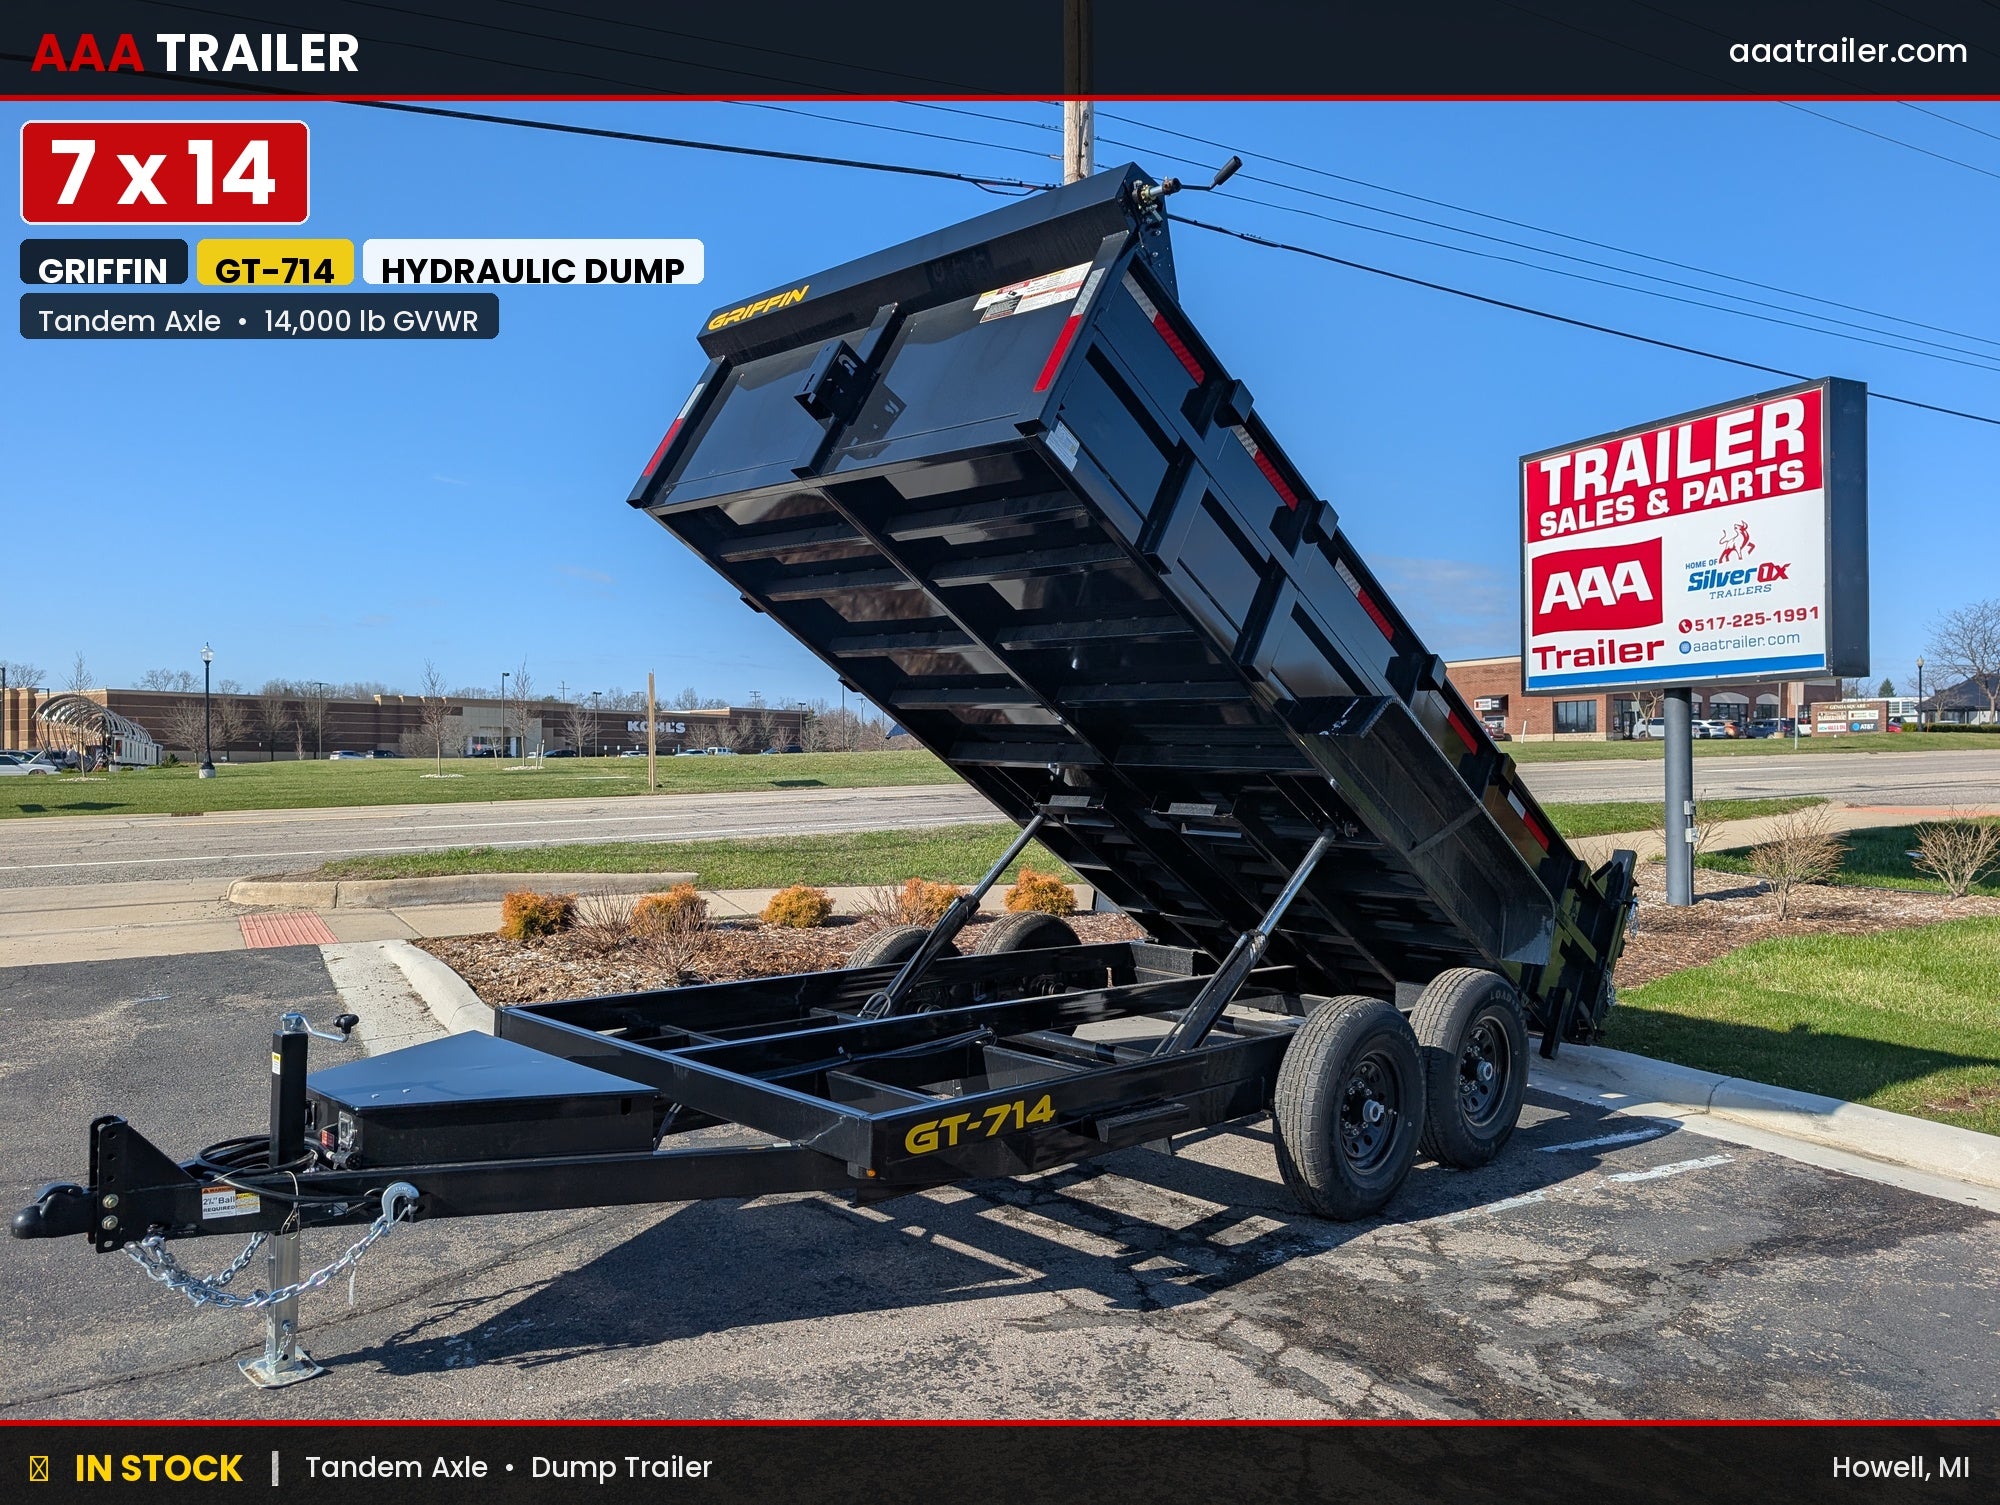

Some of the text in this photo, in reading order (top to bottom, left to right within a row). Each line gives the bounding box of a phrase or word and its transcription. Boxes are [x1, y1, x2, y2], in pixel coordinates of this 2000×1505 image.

[708, 285, 810, 330] GRIFFIN
[1540, 398, 1805, 507] TRAILER
[1540, 459, 1805, 538] SALES & PARTS
[1685, 558, 1718, 570] HOME OF
[1538, 559, 1654, 615] AAA
[1709, 583, 1772, 600] TRAILERS
[1695, 606, 1819, 632] 517-225-1991
[1532, 638, 1665, 671] Trailer
[1693, 633, 1801, 653] aaatrailer.com
[627, 720, 686, 734] KOHL'S
[904, 1094, 1056, 1155] GT-714
[218, 1195, 235, 1205] Ball
